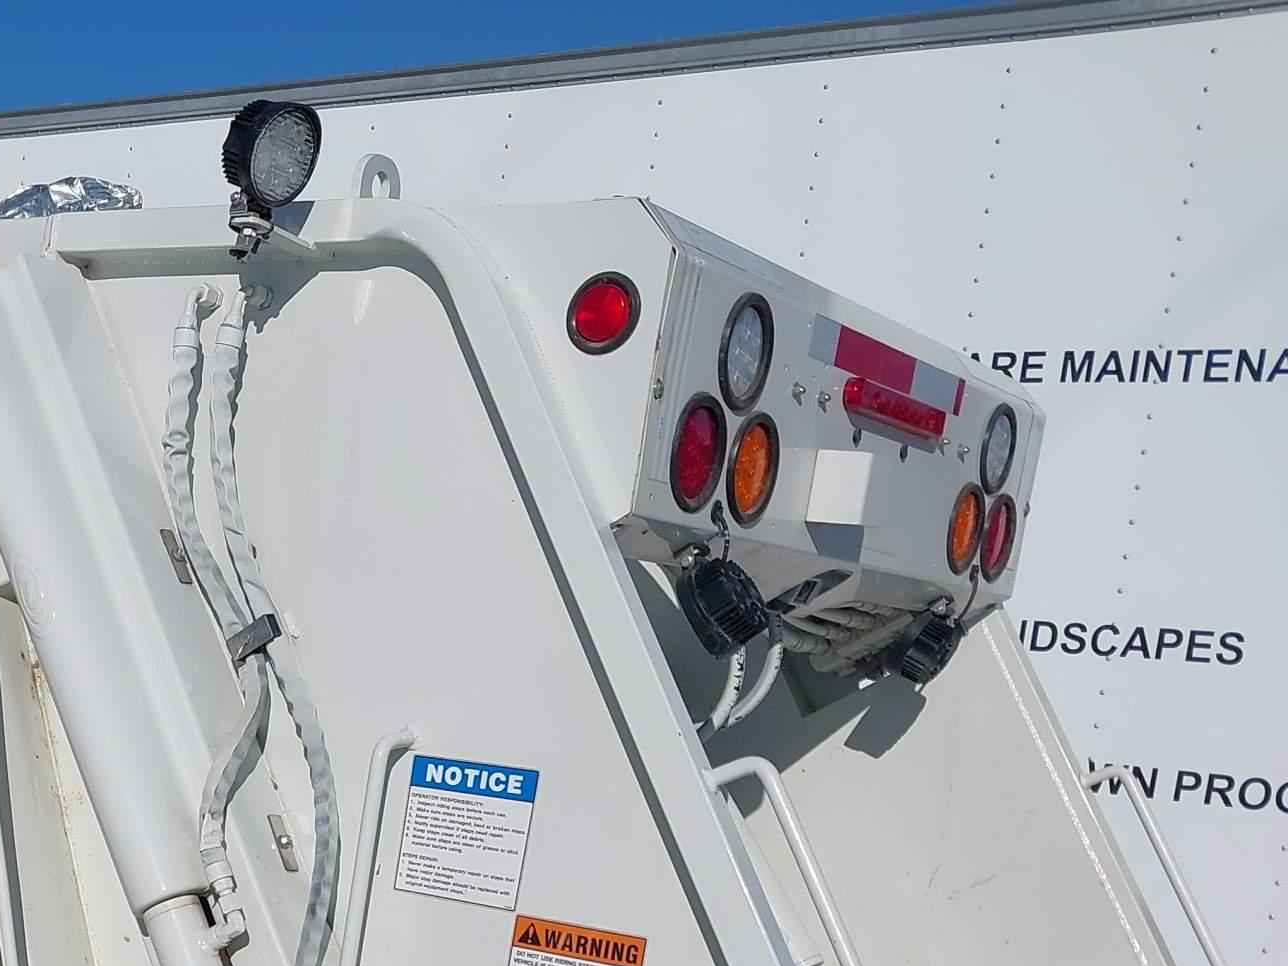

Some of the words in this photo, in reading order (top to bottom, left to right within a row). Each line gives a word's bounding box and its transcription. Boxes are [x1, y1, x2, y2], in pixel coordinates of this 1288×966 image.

[970, 351, 1047, 383] RE
[1060, 349, 1288, 383] MAINTENA
[424, 763, 525, 794] NOTICE
[513, 957, 538, 966] VEHICLE
[540, 954, 553, 962] USE
[554, 957, 576, 966] RIDING
[542, 928, 639, 965] WARNING
